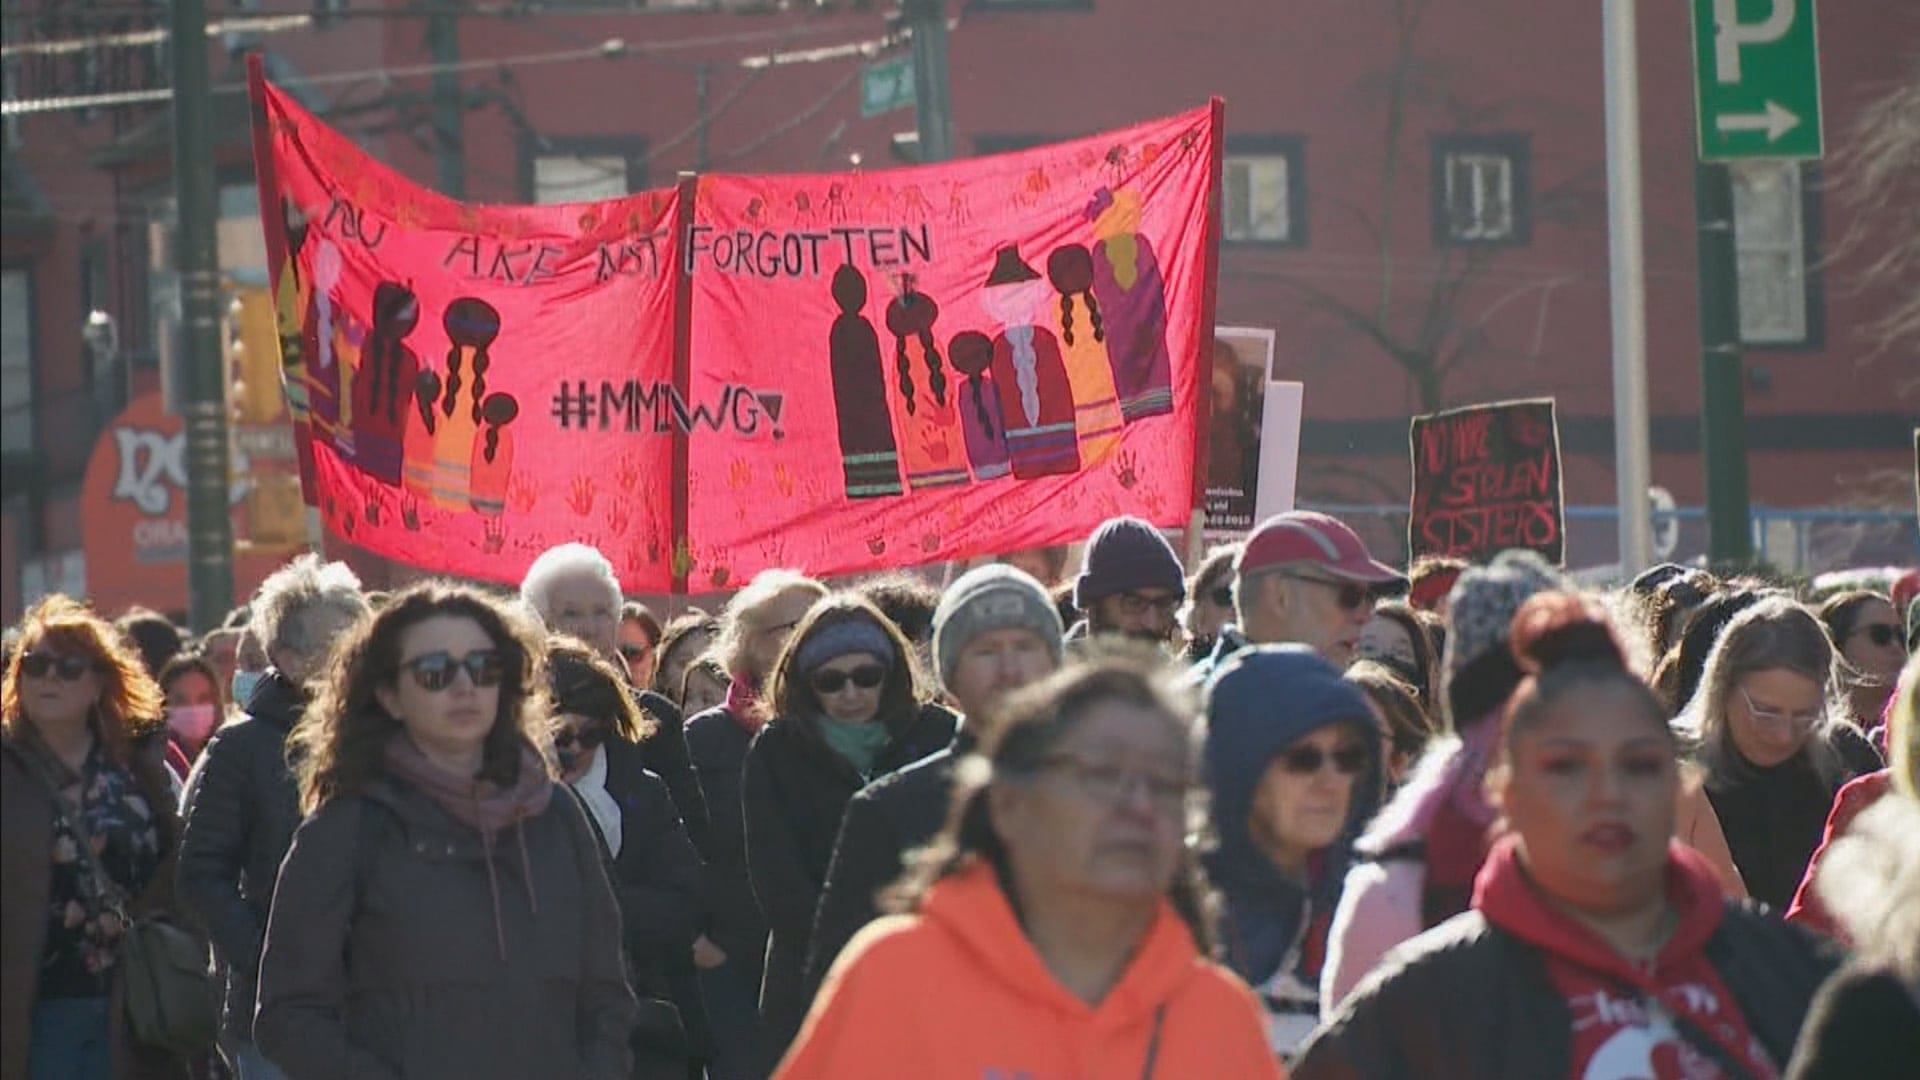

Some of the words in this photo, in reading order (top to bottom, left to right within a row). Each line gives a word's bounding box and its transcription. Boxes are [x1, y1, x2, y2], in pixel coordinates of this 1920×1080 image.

[1713, 0, 1796, 84] P
[443, 235, 563, 286] ARE
[685, 223, 932, 279] FORGOTTEN
[1440, 449, 1551, 506] STOLEN
[1422, 500, 1558, 556] SISTERS
